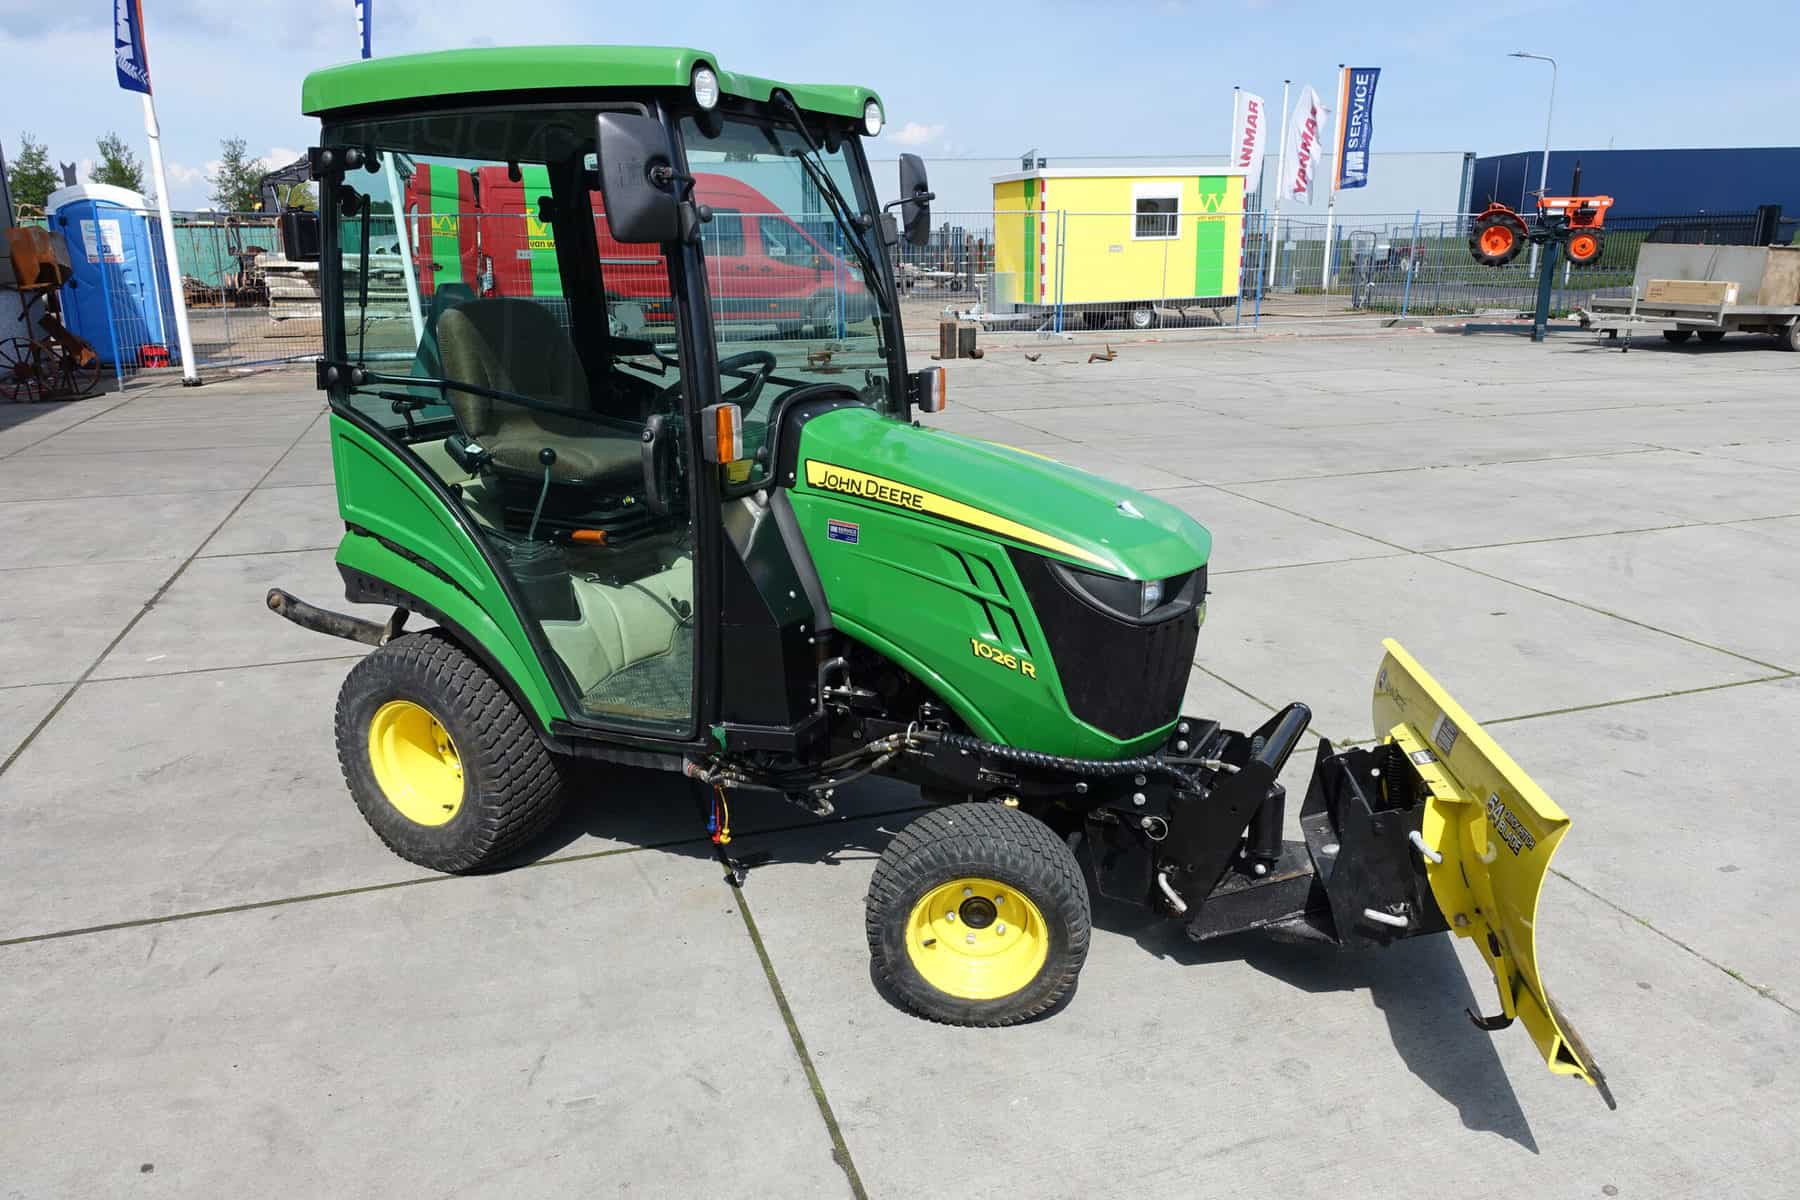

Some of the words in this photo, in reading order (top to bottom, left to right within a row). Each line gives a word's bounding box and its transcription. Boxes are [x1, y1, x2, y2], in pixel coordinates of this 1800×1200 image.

[1239, 100, 1259, 168] NMAR
[1348, 73, 1370, 149] SERVICE
[818, 470, 862, 493] JOHN
[865, 479, 924, 508] DEERE
[969, 637, 1018, 670] 1026
[1020, 658, 1037, 680] R
